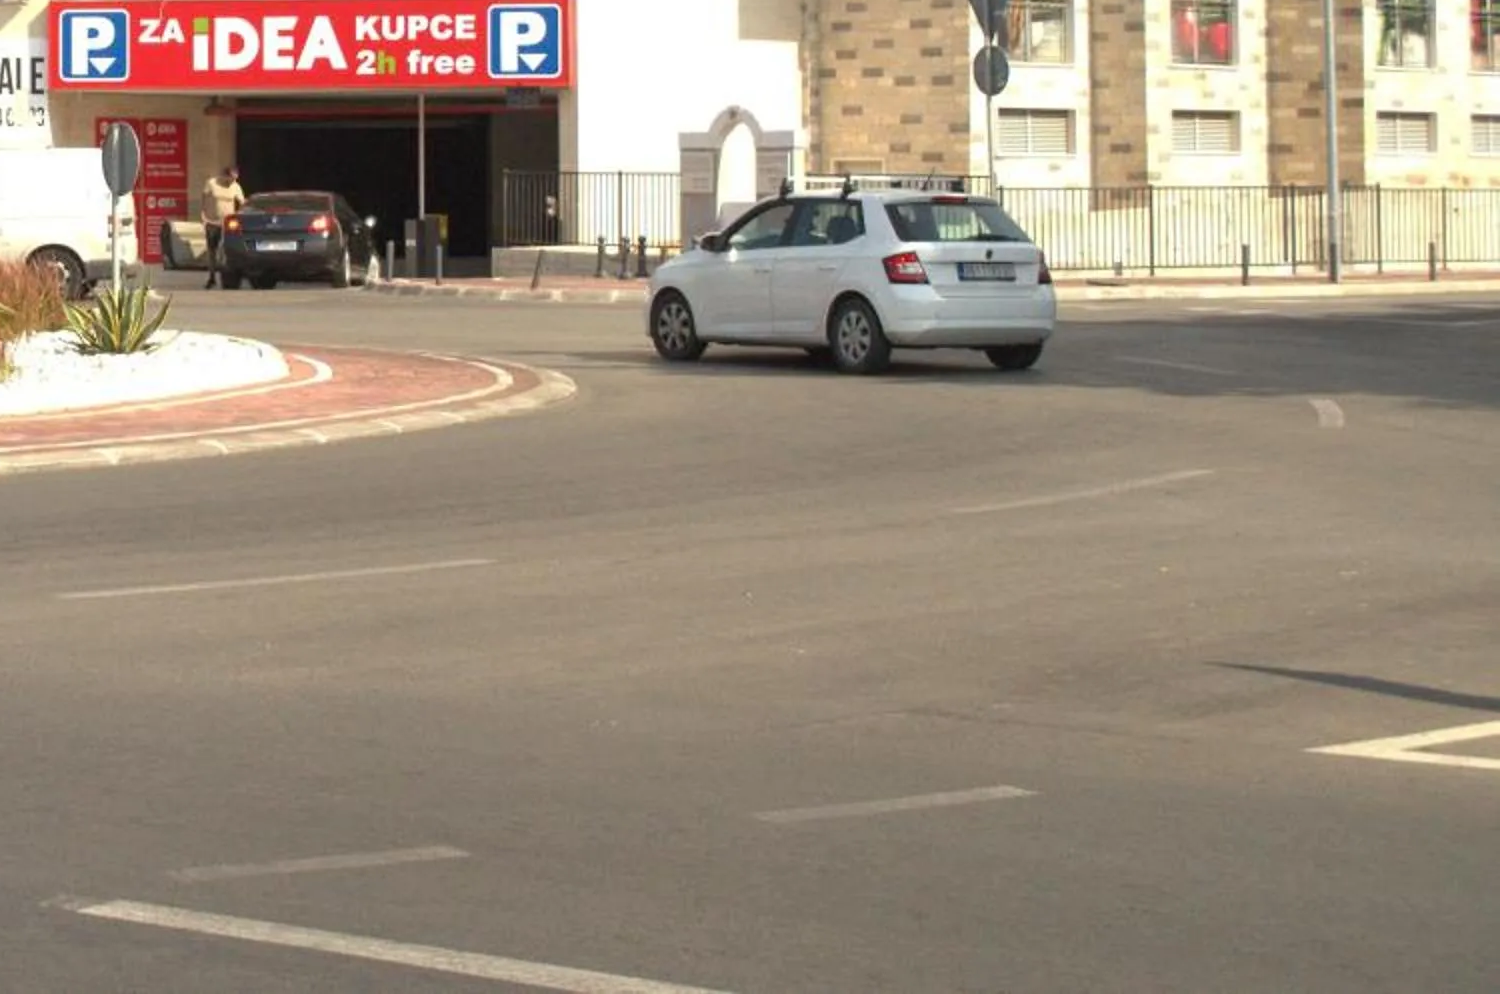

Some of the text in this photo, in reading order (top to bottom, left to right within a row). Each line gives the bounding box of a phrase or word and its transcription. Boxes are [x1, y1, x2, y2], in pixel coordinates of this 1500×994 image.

[71, 14, 477, 75] P ZA iDEA KUPCE
[355, 49, 476, 75] 2h free
[500, 11, 548, 72] P
